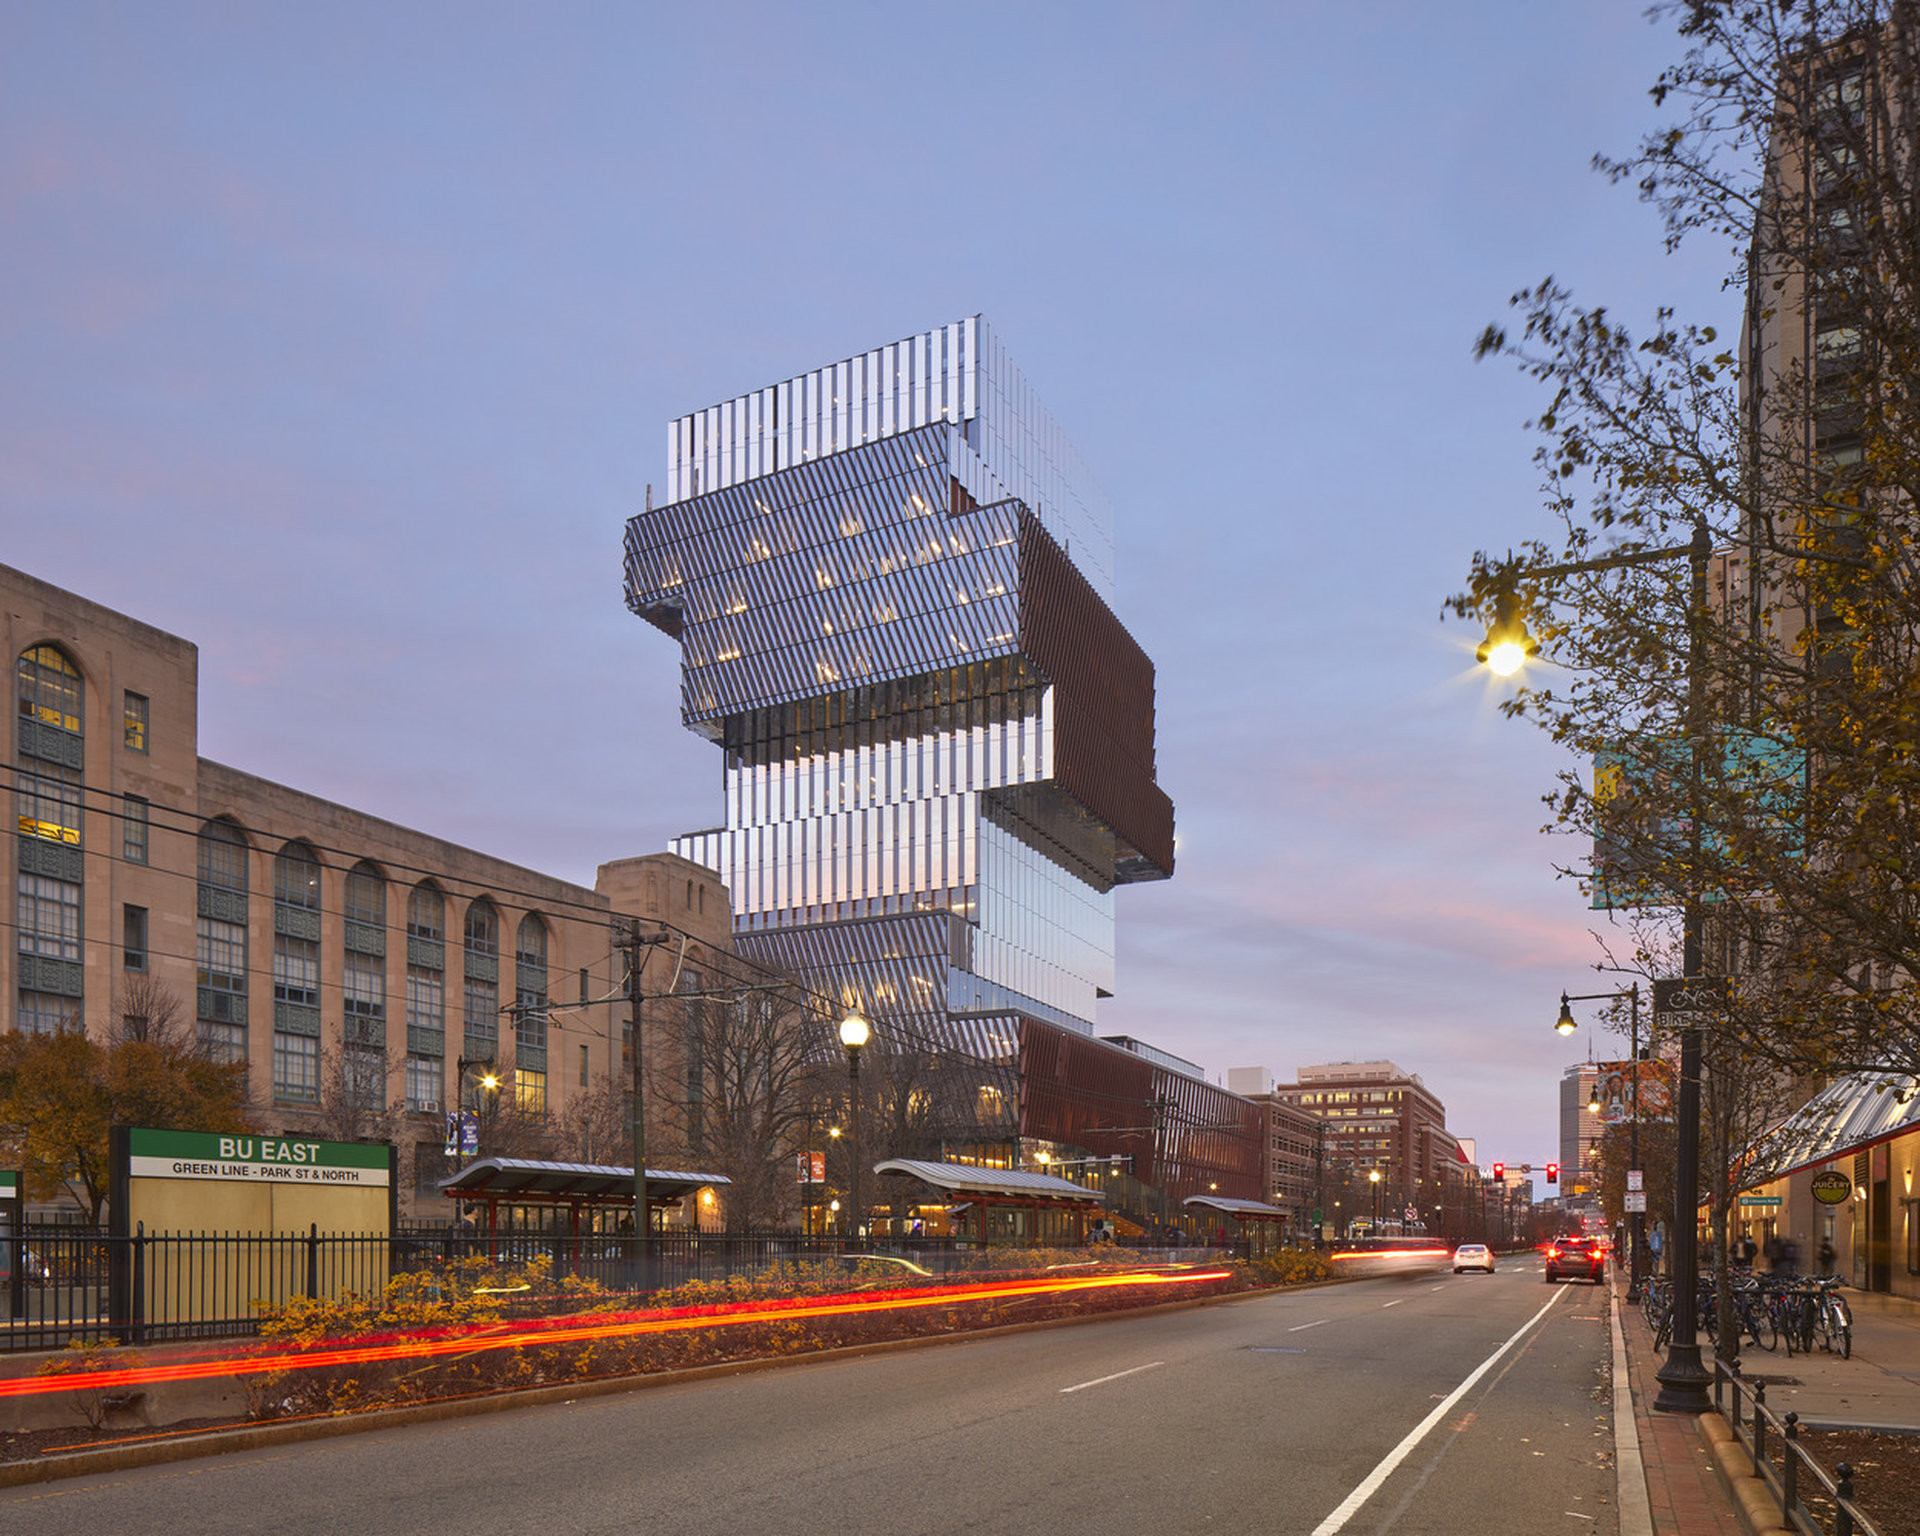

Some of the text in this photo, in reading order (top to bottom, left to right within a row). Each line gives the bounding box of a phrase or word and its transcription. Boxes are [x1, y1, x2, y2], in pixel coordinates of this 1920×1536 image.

[1660, 1013, 1690, 1025] BIKE
[219, 1138, 321, 1163] BU EAST
[172, 1162, 218, 1175] GREEN
[221, 1165, 249, 1176] LINE
[260, 1167, 292, 1178] PARK
[295, 1168, 310, 1179] ST
[312, 1169, 320, 1180] &
[322, 1170, 359, 1181] NORTH
